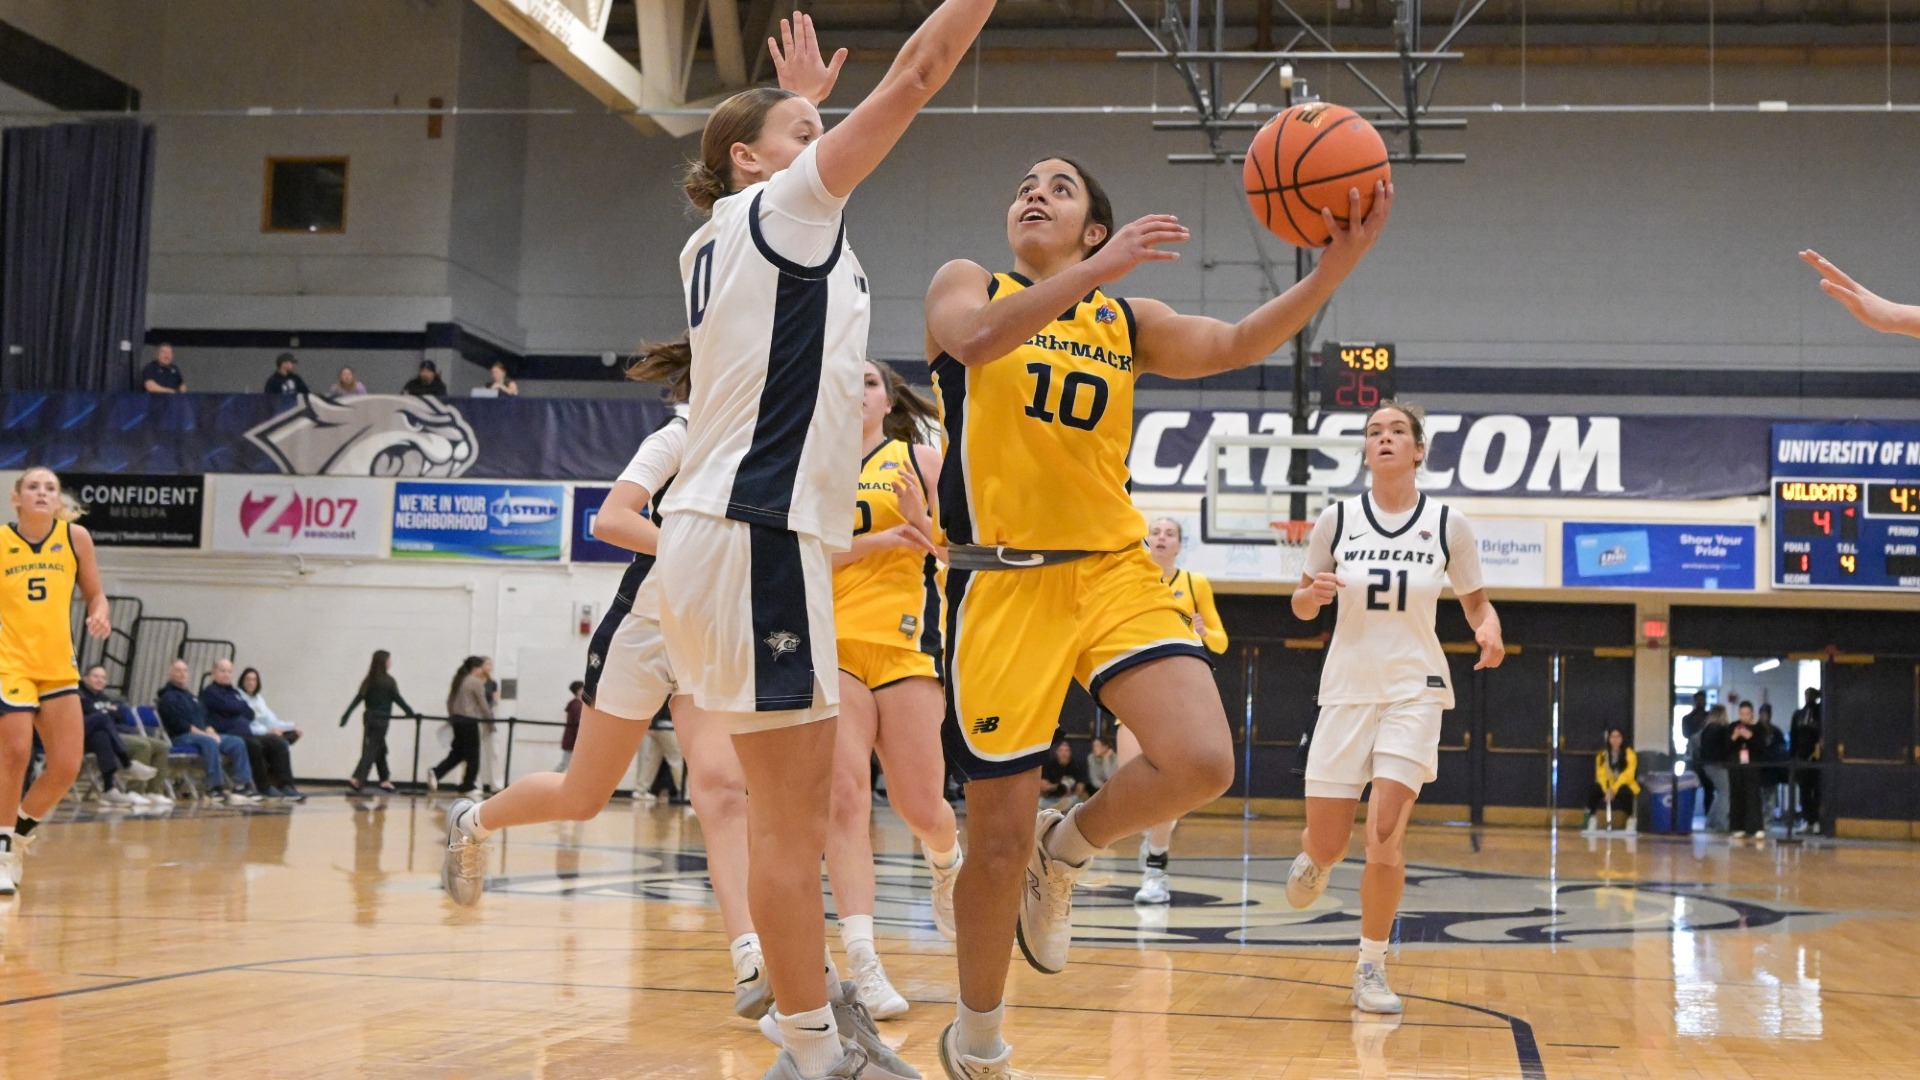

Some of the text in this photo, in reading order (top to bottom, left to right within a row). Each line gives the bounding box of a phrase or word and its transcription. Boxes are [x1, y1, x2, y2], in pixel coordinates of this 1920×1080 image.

[1340, 347, 1389, 371] 4:58
[1024, 362, 1109, 432] 10
[1335, 371, 1379, 406] 26
[1778, 440, 1879, 465] UNIVERSITY
[1880, 441, 1905, 465] OF
[81, 484, 199, 505] CONFIDENT
[1782, 482, 1858, 502] WILDCATS
[109, 506, 168, 518] MEDSPA
[398, 494, 487, 513] WE'RE IN YOUR
[396, 512, 489, 531] NEIGHBORHOOD
[1812, 510, 1831, 535] 4
[303, 530, 356, 540] seacoast
[1680, 534, 1743, 546] Show Your
[1482, 540, 1542, 555] Brigham
[1695, 545, 1727, 557] Pride
[1885, 544, 1917, 555] PLAYER
[1344, 550, 1434, 565] WILDCATS
[1840, 555, 1855, 573] 4
[27, 577, 47, 601] 5
[1367, 568, 1408, 612] 21
